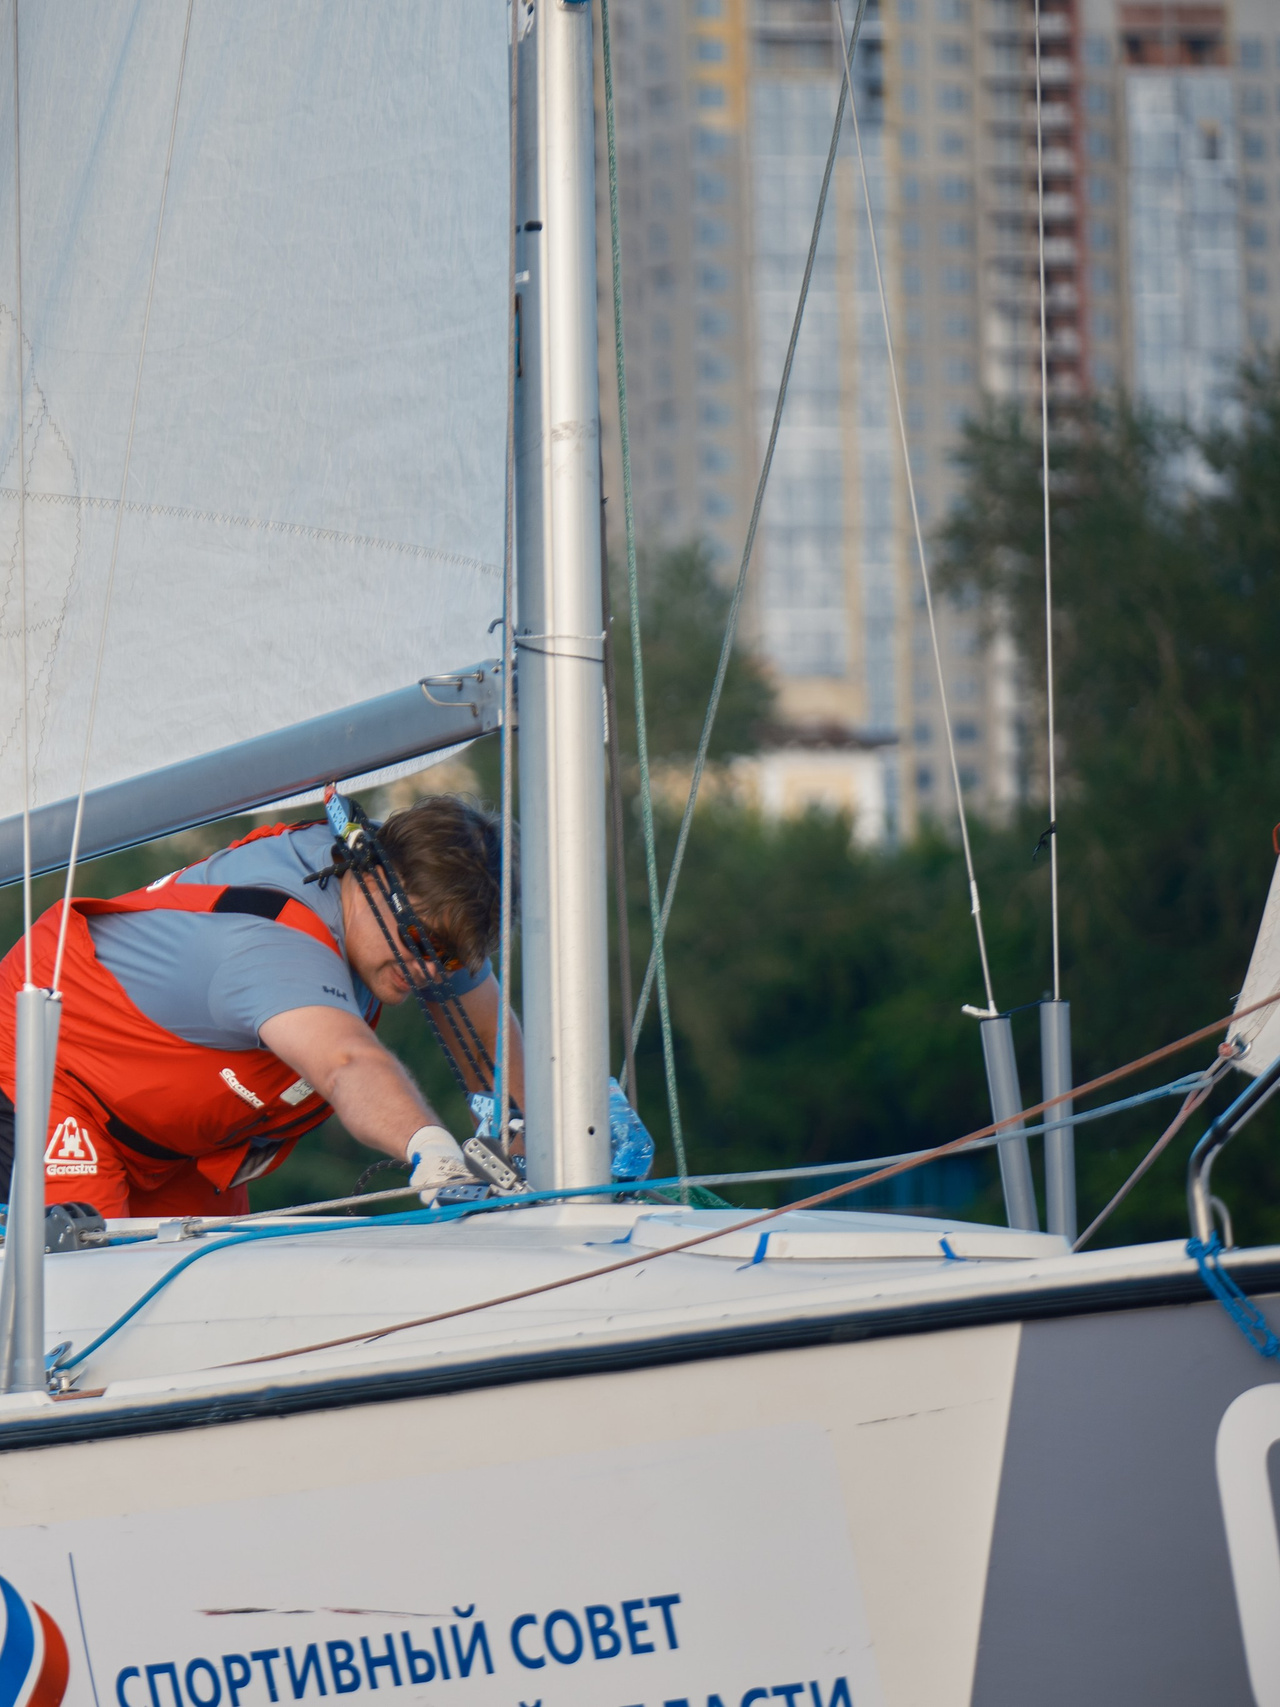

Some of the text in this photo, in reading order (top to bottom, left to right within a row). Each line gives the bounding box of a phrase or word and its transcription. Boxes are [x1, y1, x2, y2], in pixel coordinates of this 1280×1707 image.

[220, 1067, 265, 1109] Gaastra
[46, 1163, 98, 1176] Gaastra
[116, 1593, 682, 1707] СПОРТИВНЫЙ СОВЕТ
